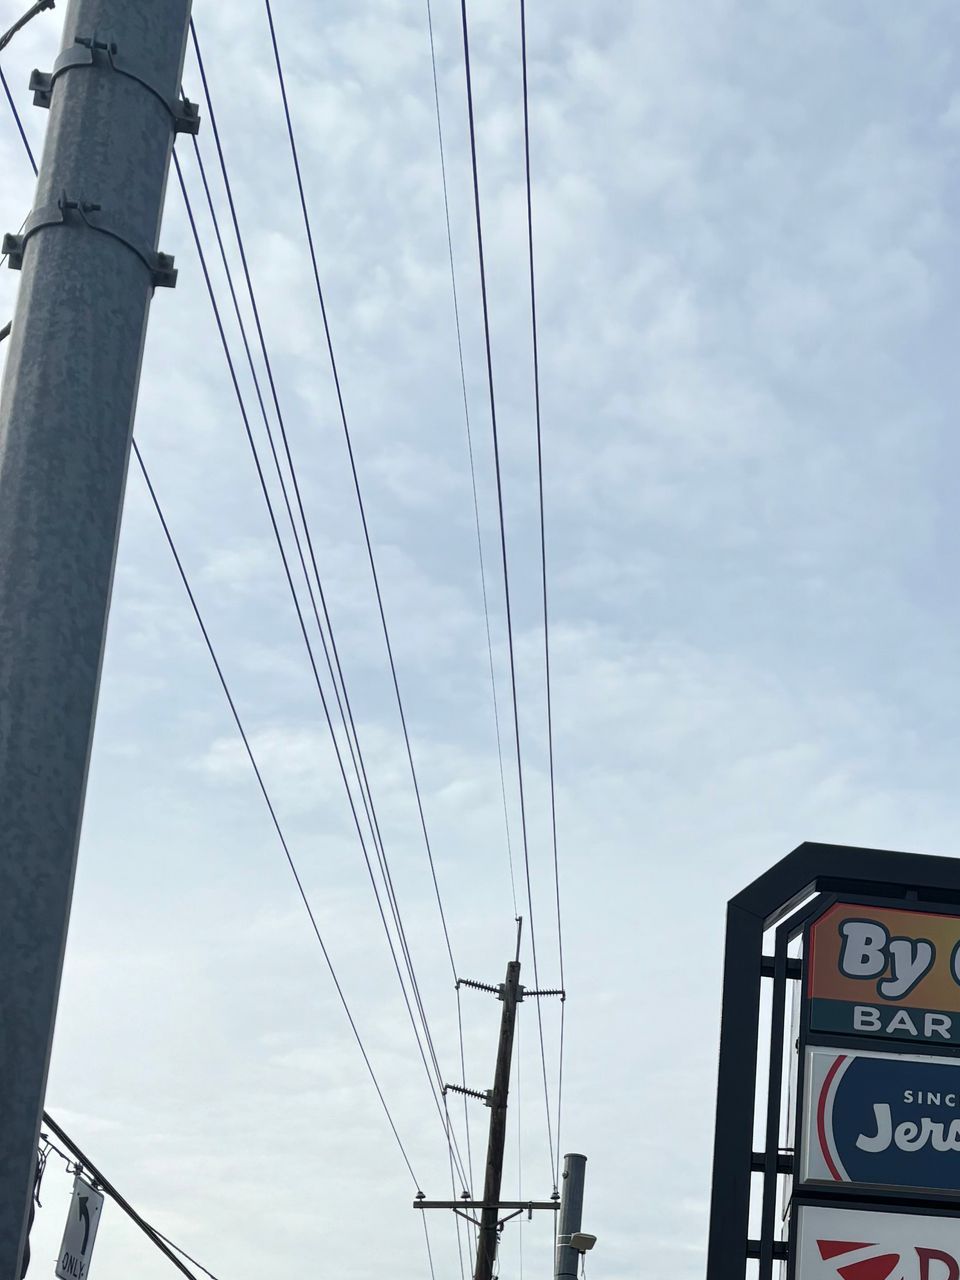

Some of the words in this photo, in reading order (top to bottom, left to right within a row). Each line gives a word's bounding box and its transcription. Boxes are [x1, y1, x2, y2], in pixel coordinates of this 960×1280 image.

[839, 919, 935, 999] By
[853, 1006, 953, 1039] BAR
[61, 1252, 86, 1279] ONLY
